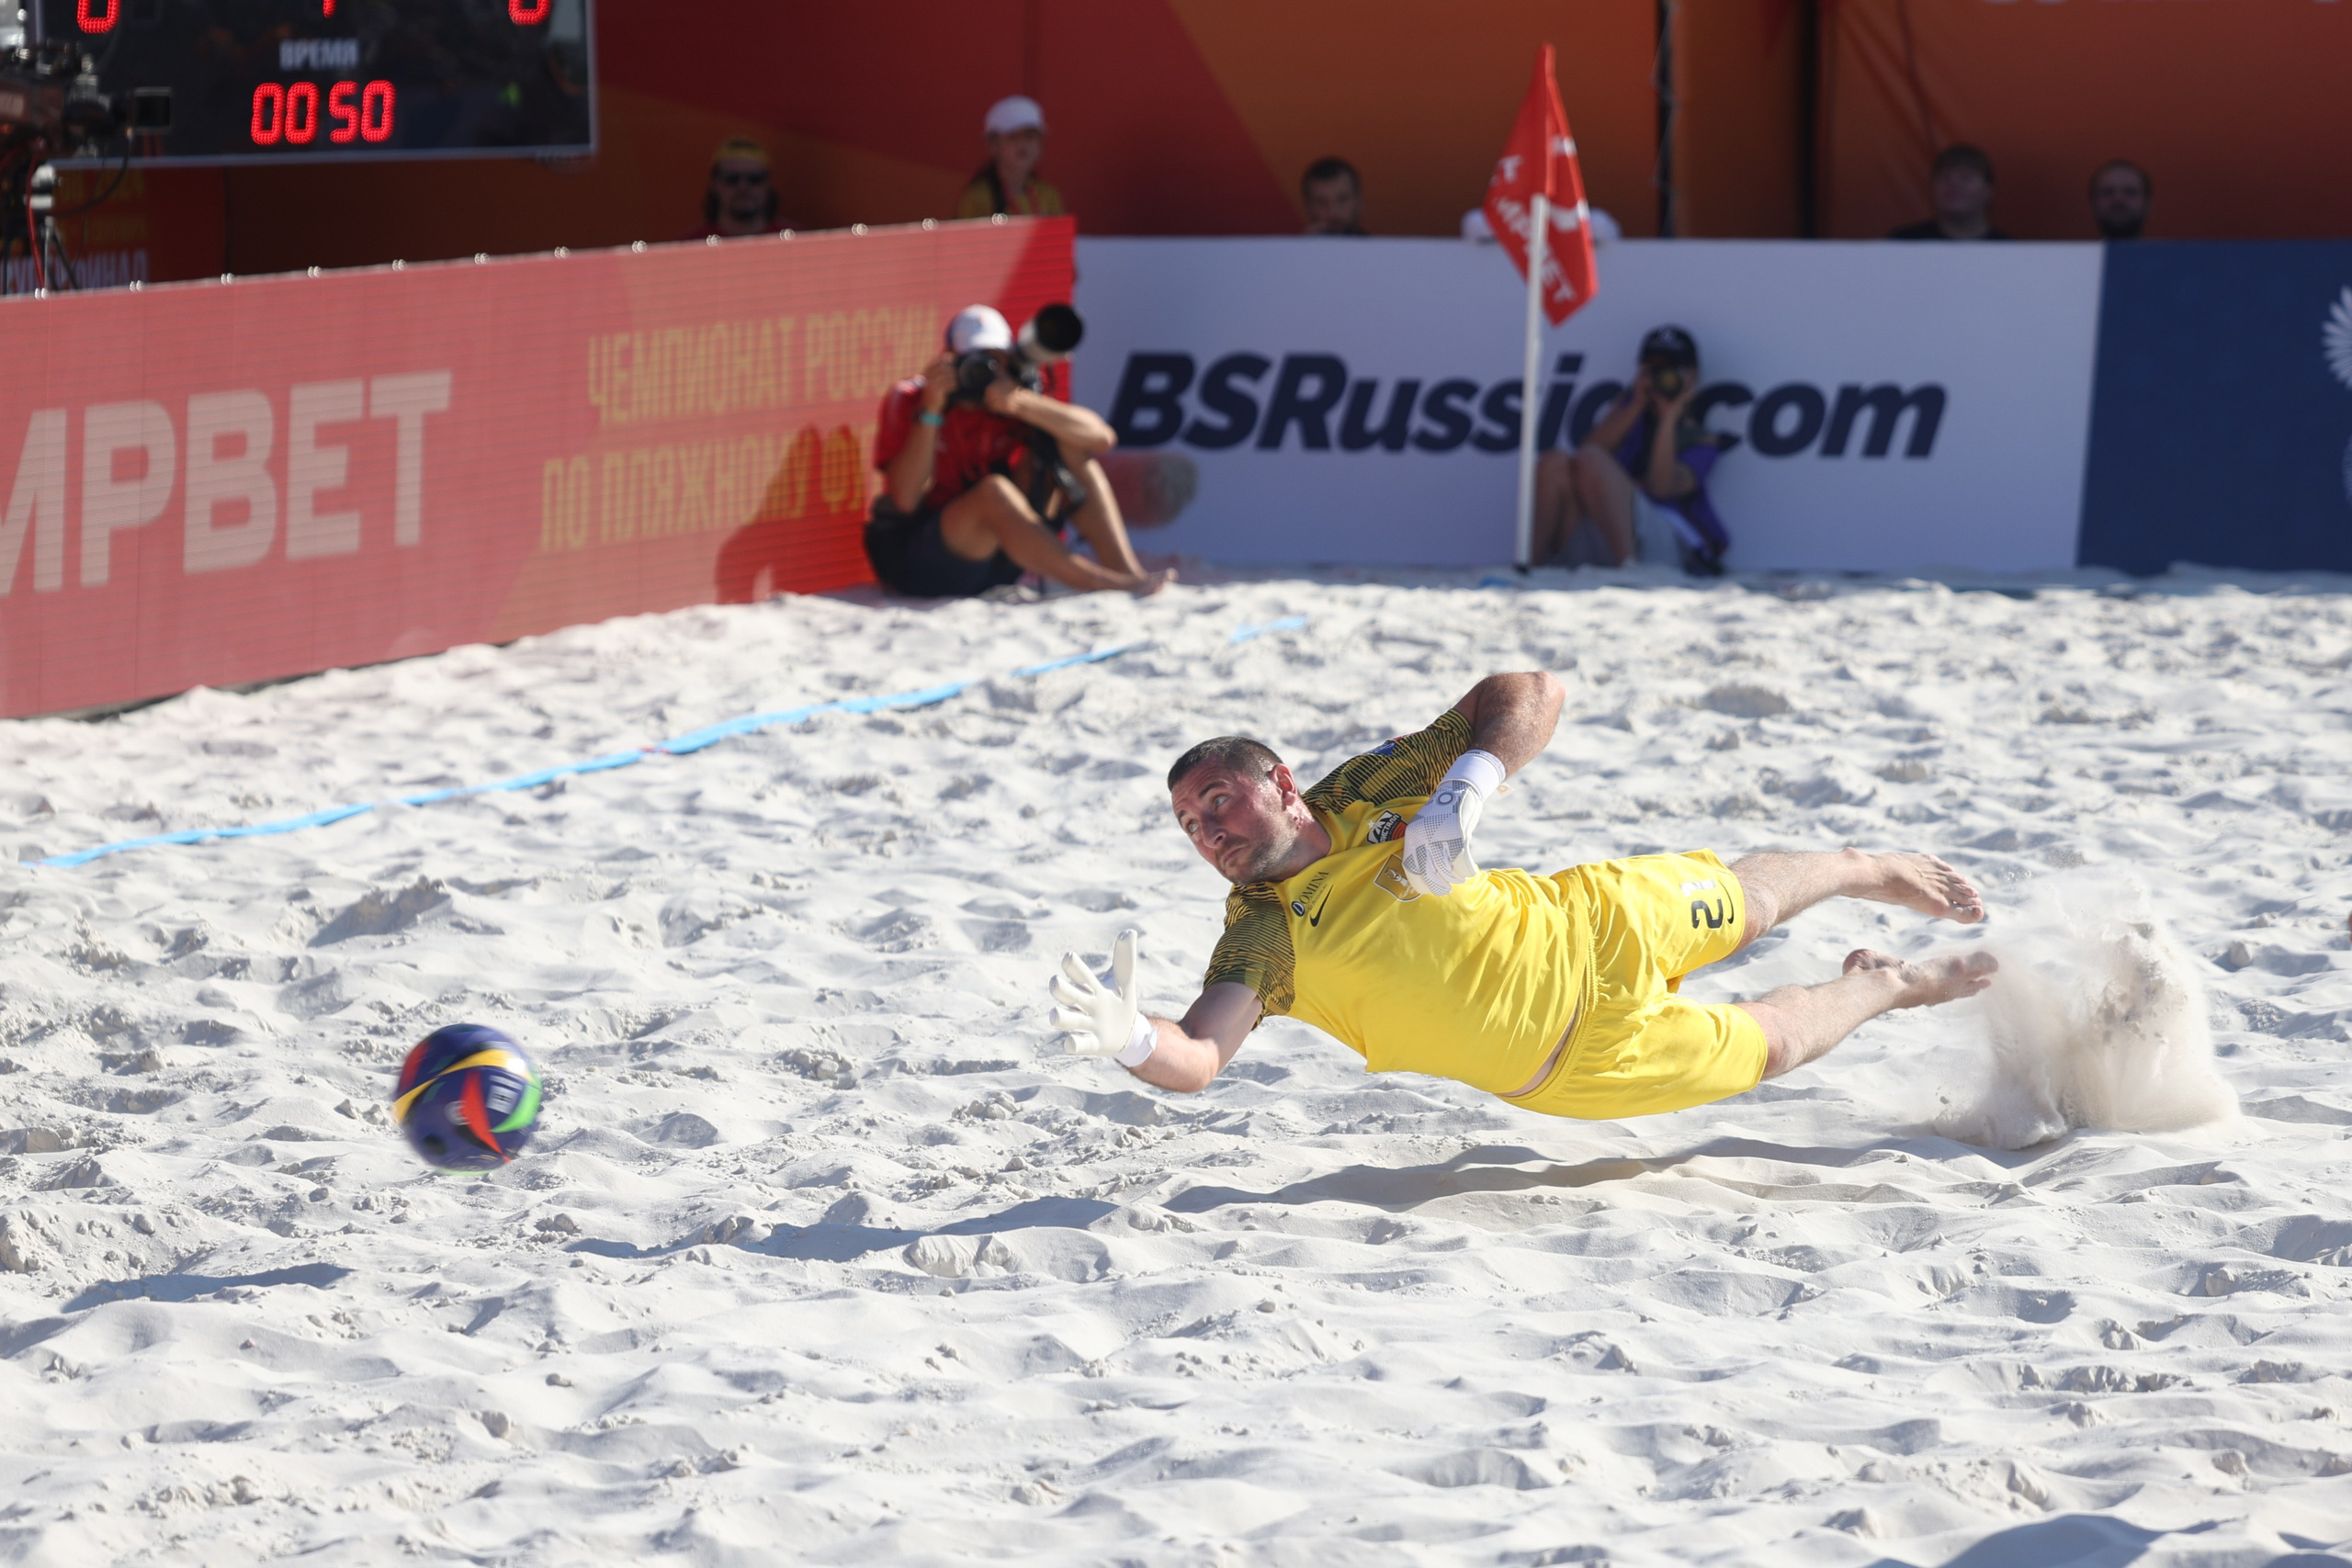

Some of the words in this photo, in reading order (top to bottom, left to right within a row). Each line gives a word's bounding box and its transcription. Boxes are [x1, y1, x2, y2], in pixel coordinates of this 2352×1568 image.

[588, 316, 796, 425] ЧЕМПИОНАТ
[805, 304, 937, 401] РОССИИ
[1105, 352, 1948, 461] BSRussicom
[542, 454, 593, 554] ПО
